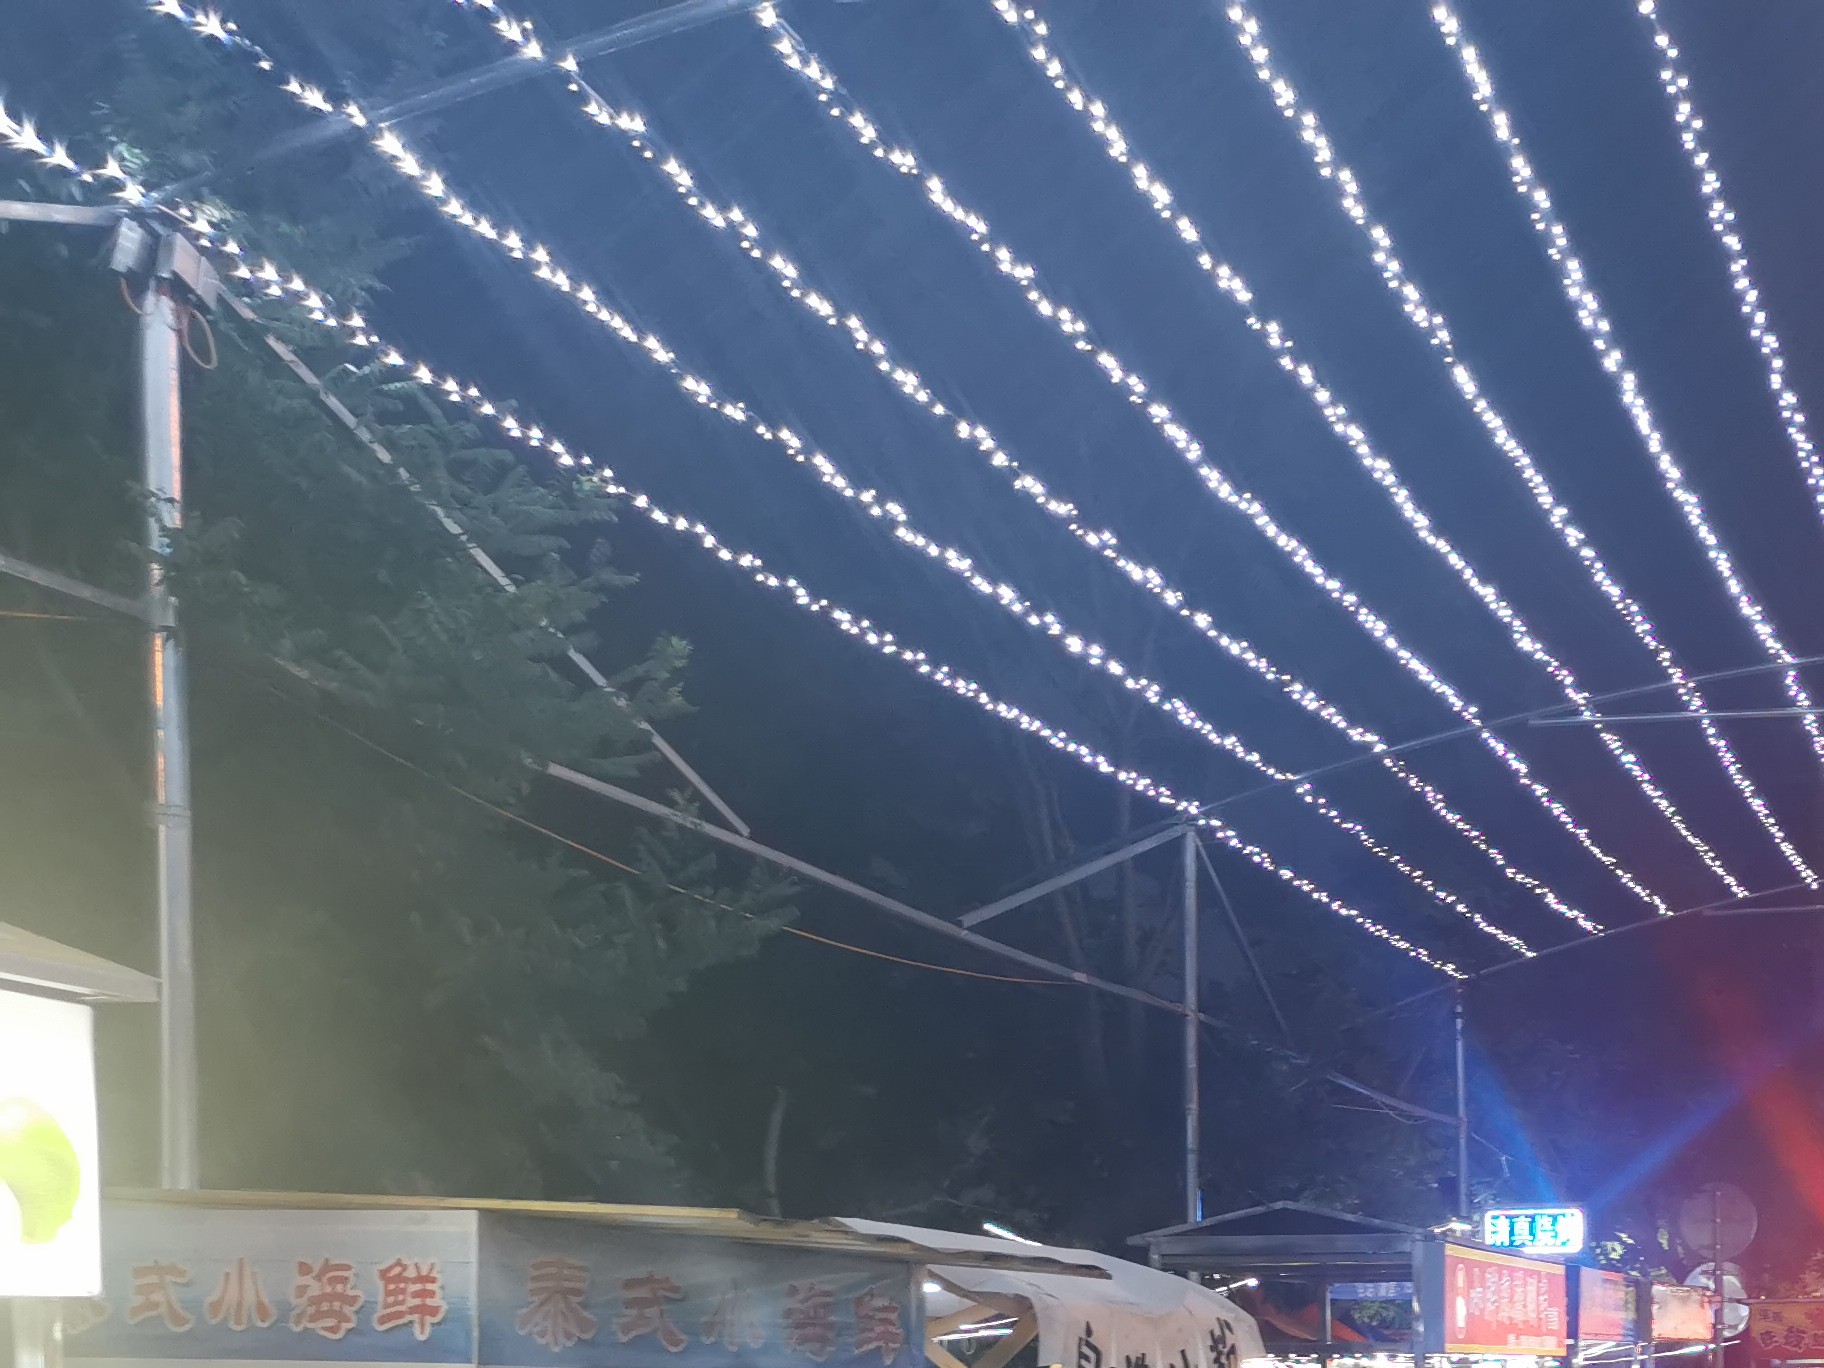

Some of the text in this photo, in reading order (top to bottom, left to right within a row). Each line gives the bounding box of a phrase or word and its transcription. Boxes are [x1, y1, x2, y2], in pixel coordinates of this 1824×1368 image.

[64, 1254, 450, 1341] 式小海鲜
[514, 1256, 904, 1366] 泰式小海鲜
